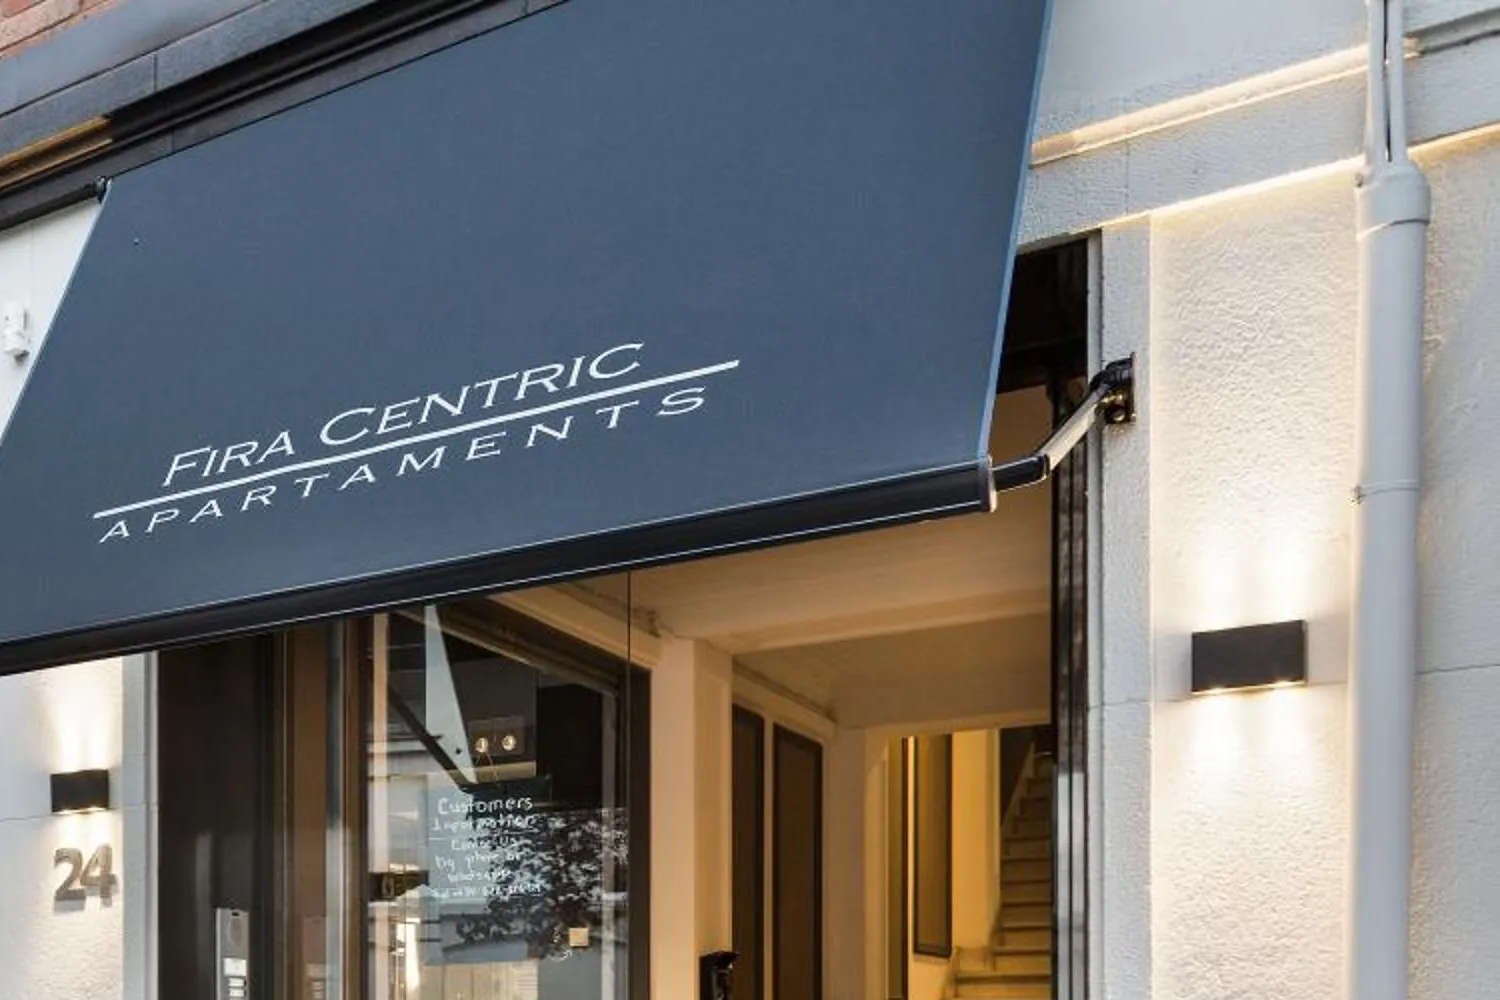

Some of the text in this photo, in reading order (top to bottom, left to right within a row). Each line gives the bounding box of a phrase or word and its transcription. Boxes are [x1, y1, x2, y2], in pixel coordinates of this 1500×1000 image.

[98, 386, 707, 544] APARTAMENTS
[437, 797, 533, 815] Customers
[53, 842, 118, 908] 24
